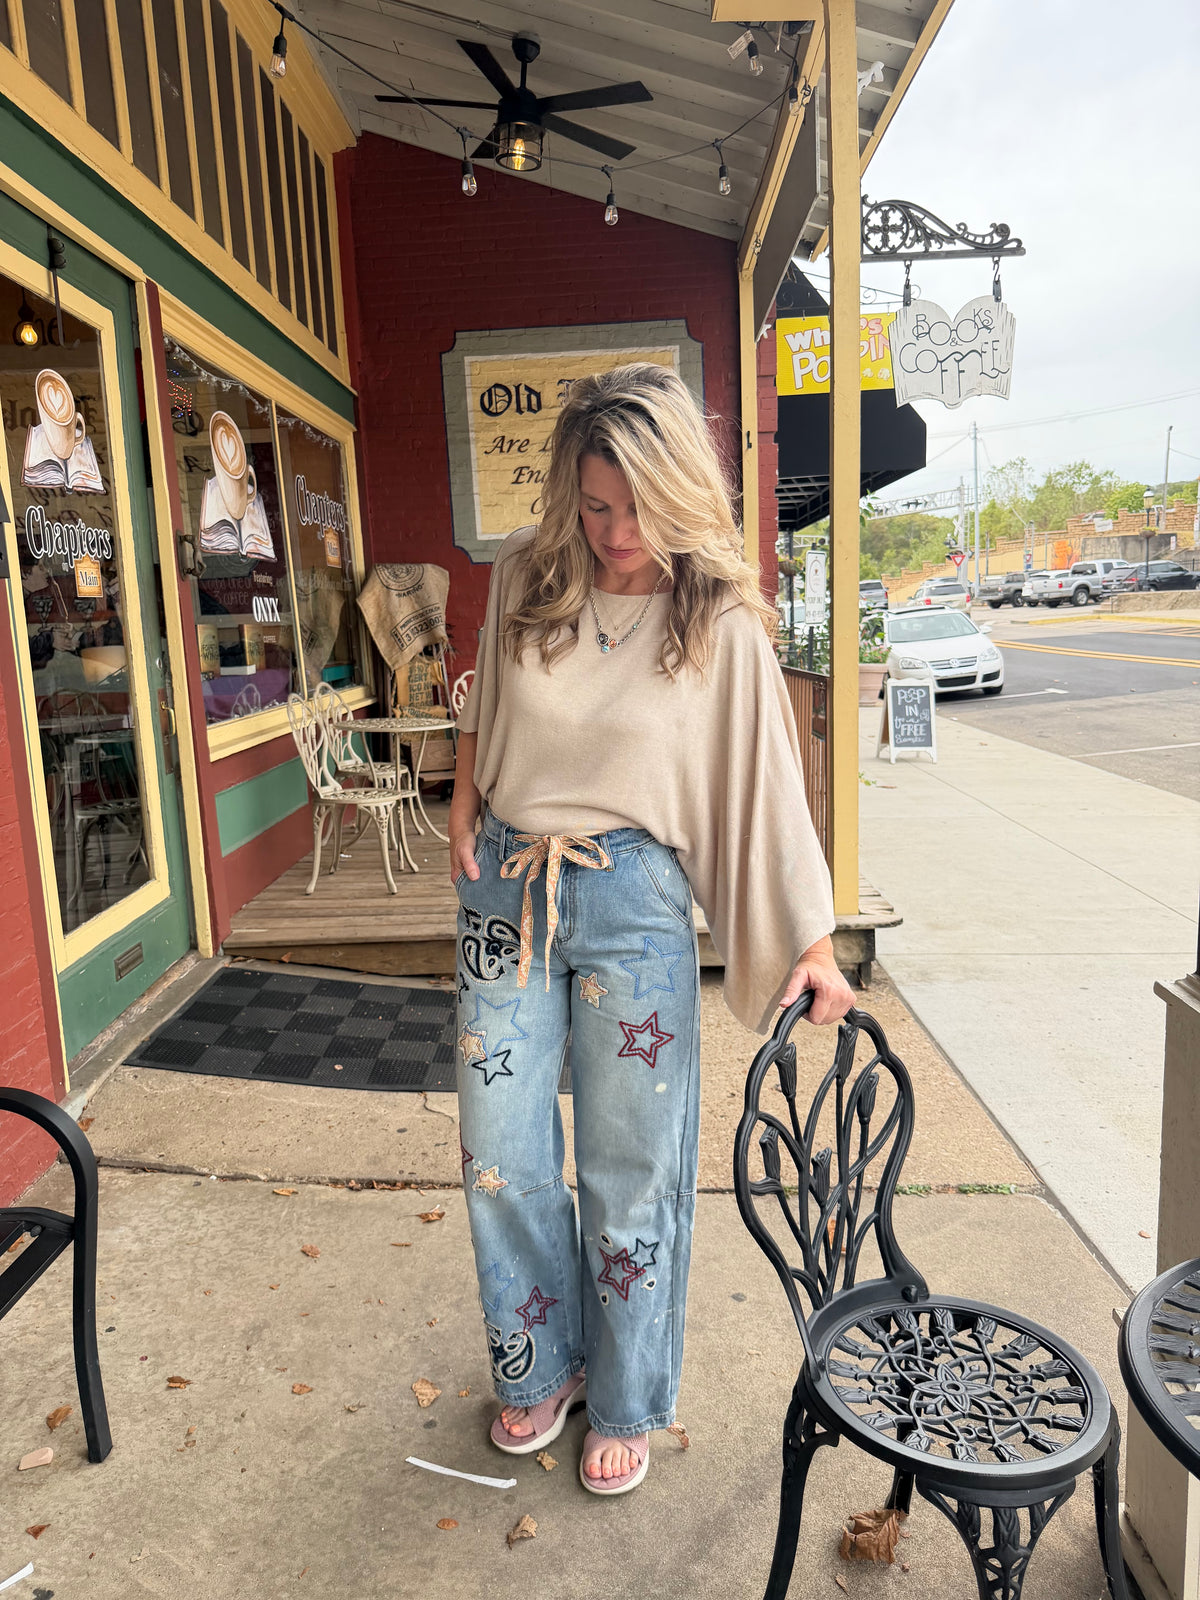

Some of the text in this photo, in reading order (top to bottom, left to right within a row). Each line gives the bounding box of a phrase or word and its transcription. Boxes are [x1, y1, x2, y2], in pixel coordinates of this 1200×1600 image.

[912, 308, 994, 345] BOOKS
[949, 337, 963, 346] &
[899, 340, 1010, 398] COFFEE
[479, 382, 543, 417] Old
[484, 435, 530, 454] Are
[294, 474, 346, 538] Chapters
[25, 505, 113, 569] Chapters
[79, 570, 99, 586] Main
[252, 595, 281, 622] ONYX
[905, 704, 919, 717] IN
[900, 723, 927, 737] FREE
